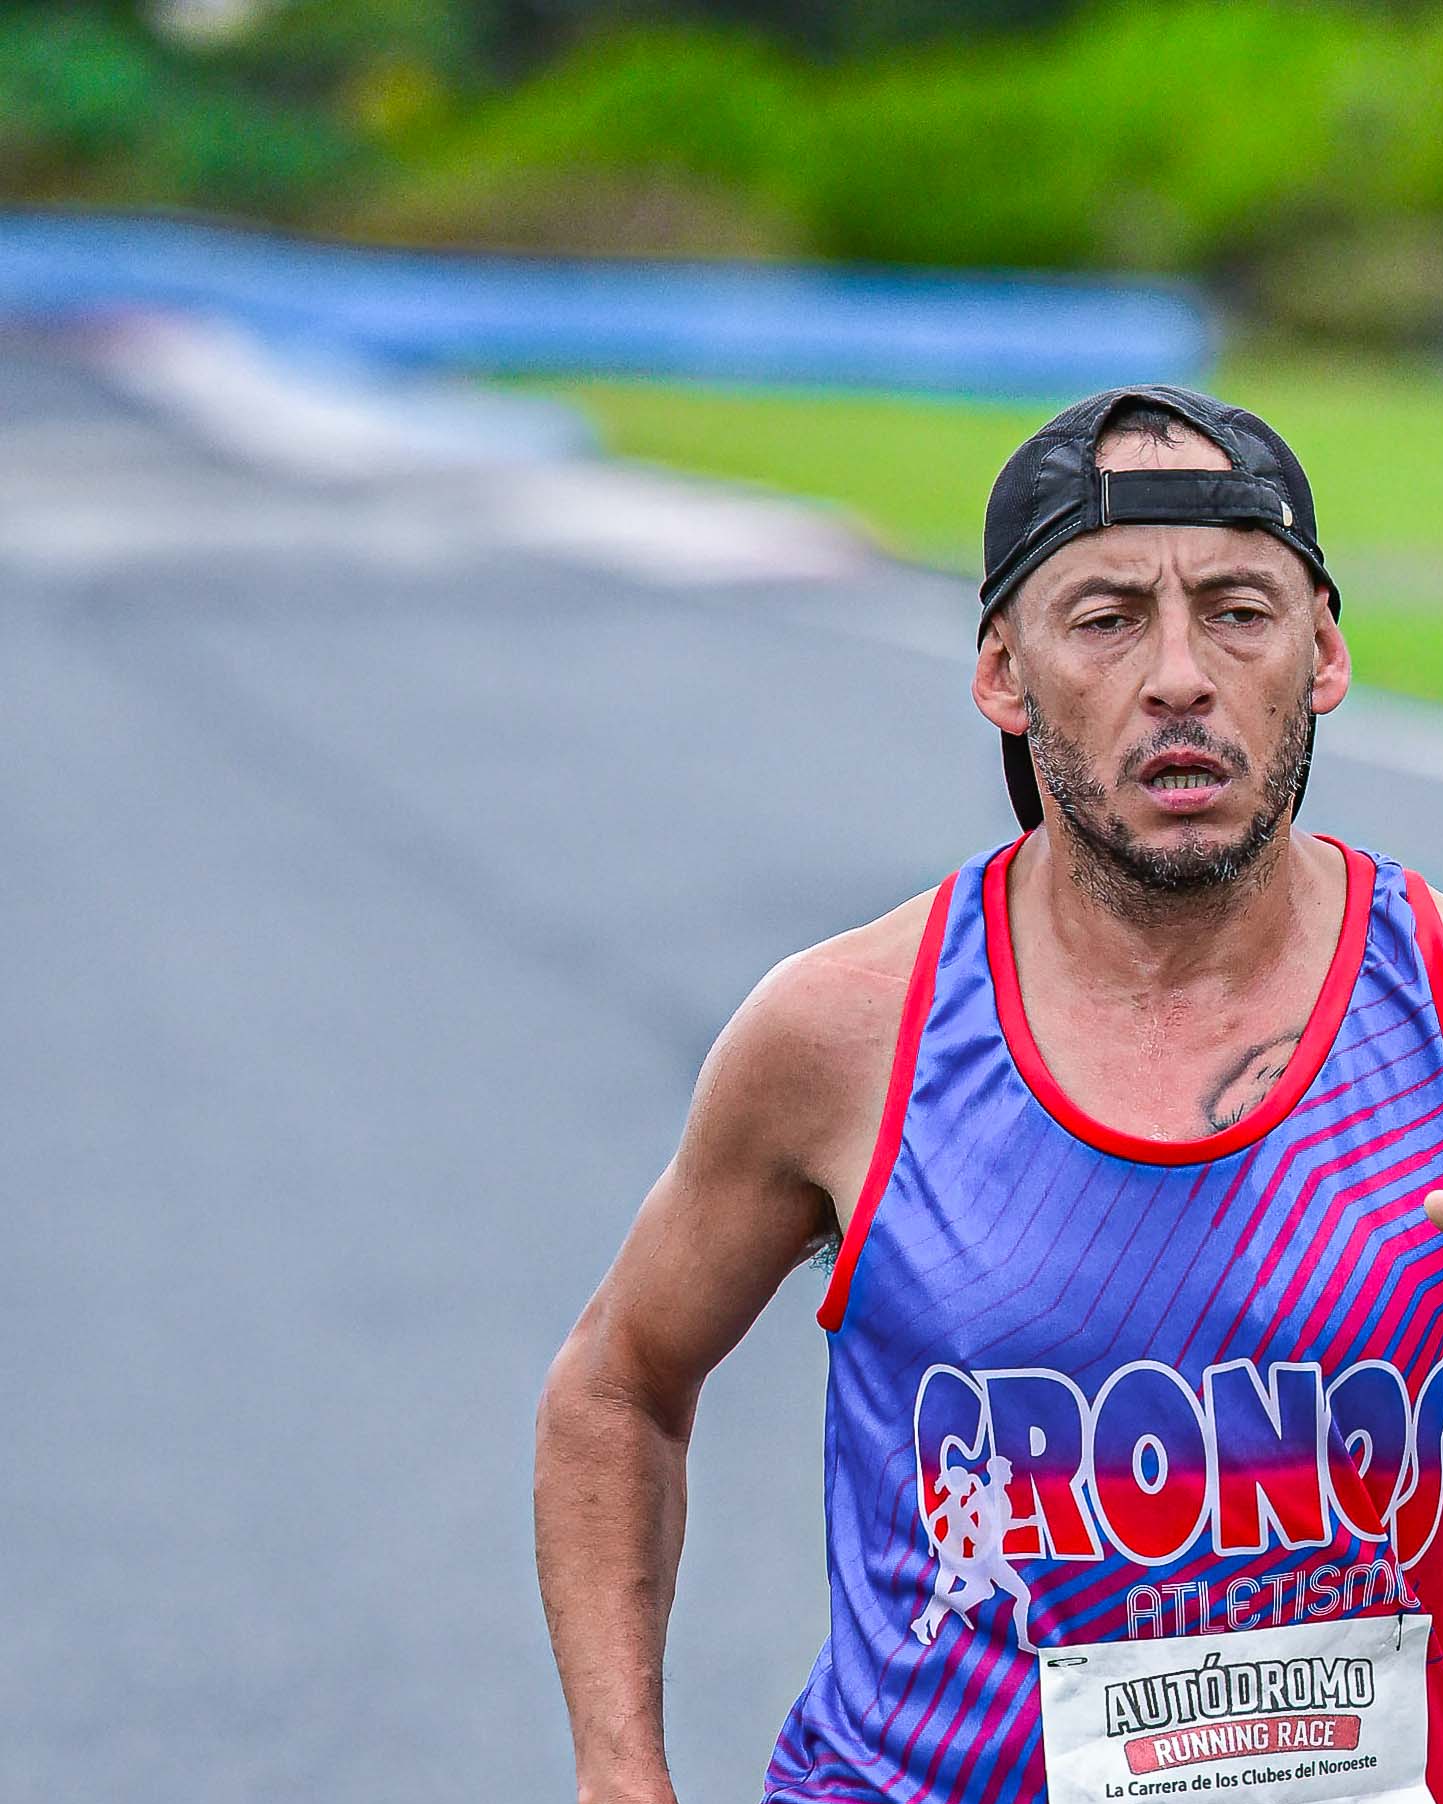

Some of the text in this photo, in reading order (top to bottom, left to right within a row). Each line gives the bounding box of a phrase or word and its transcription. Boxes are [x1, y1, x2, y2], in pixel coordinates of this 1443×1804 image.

[1105, 1653, 1375, 1737] AUTÓDROMO
[1153, 1719, 1336, 1768] RUNNING RACE
[1105, 1754, 1378, 1799] La Carrera de los Clubes del Noroeste
